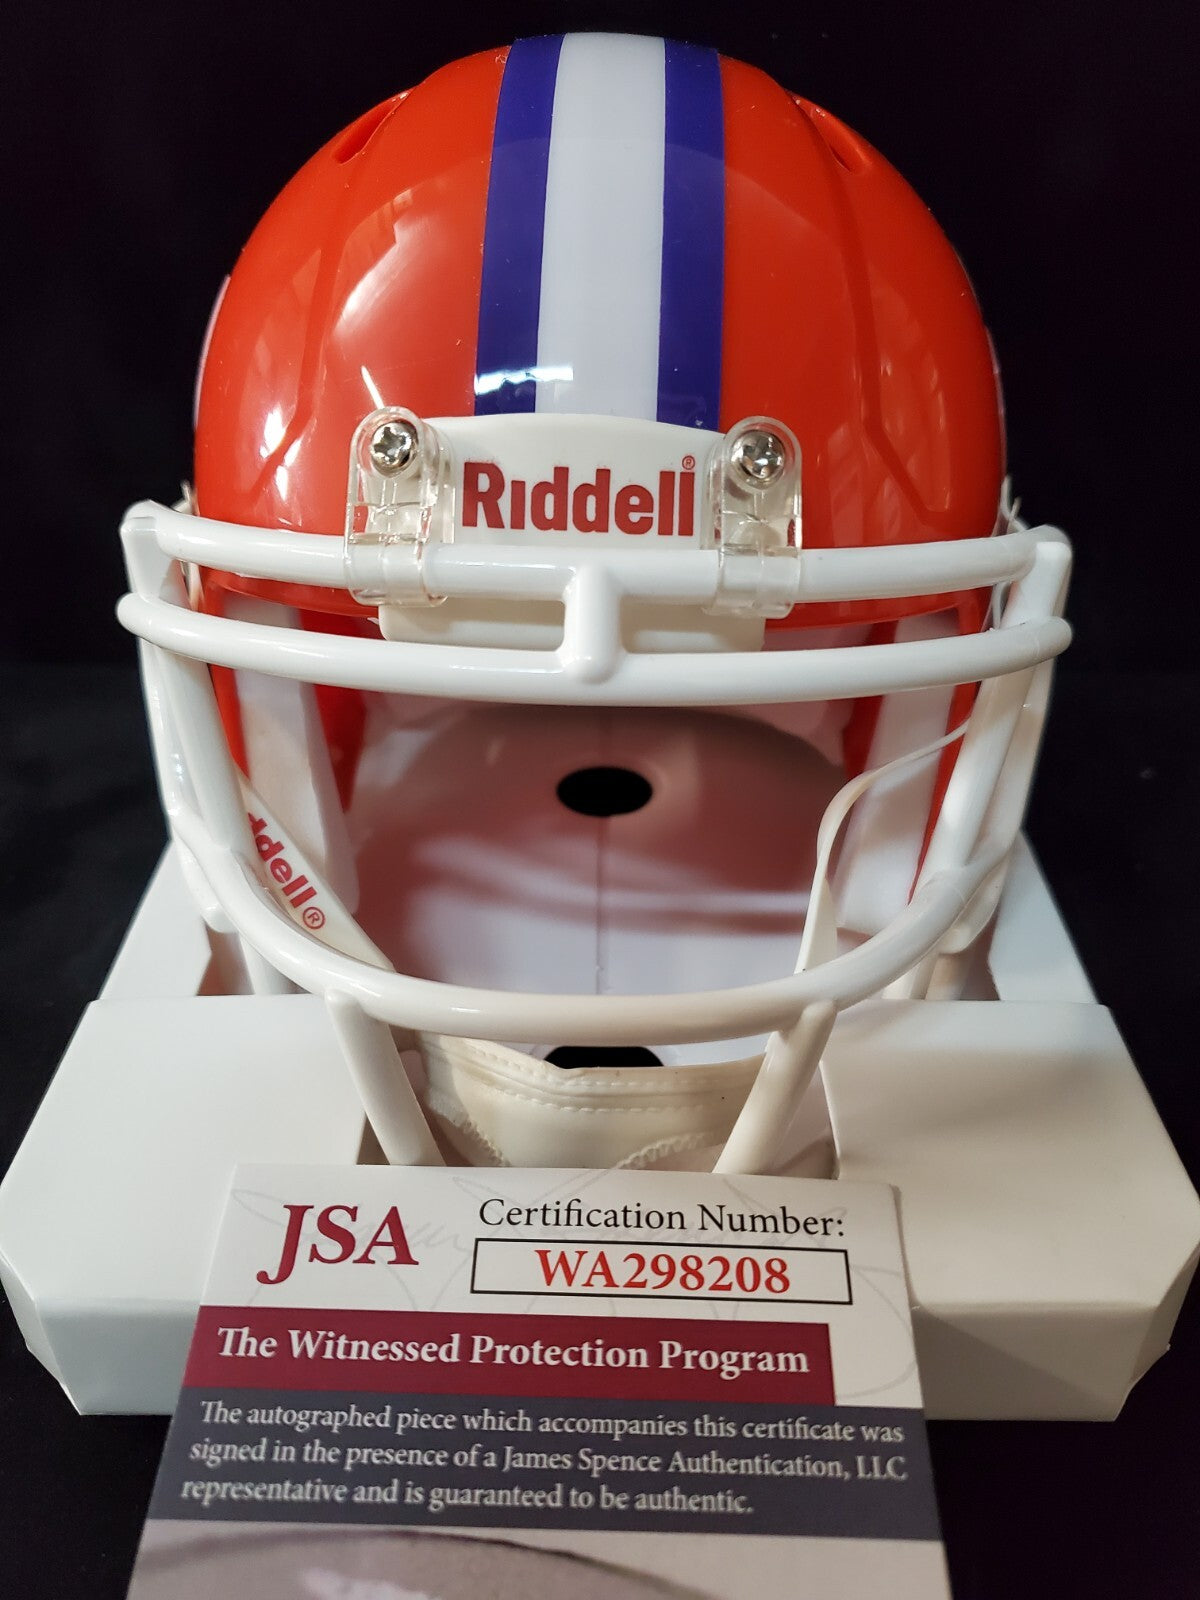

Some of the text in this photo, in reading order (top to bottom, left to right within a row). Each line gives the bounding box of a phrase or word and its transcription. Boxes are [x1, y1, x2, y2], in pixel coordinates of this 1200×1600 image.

[462, 461, 696, 537] Riddell
[479, 1198, 845, 1237] Certification Number:
[256, 1204, 419, 1285] JSA
[534, 1249, 790, 1294] WA298208
[217, 1326, 810, 1380] The Witnessed Protection Program
[201, 1400, 905, 1443] The autographed piece which accompanies this certificate was
[189, 1438, 908, 1481] signed in the presence of a James Spence Authentication, LLC
[180, 1478, 754, 1514] representative and is guaranteed to be authentic.
